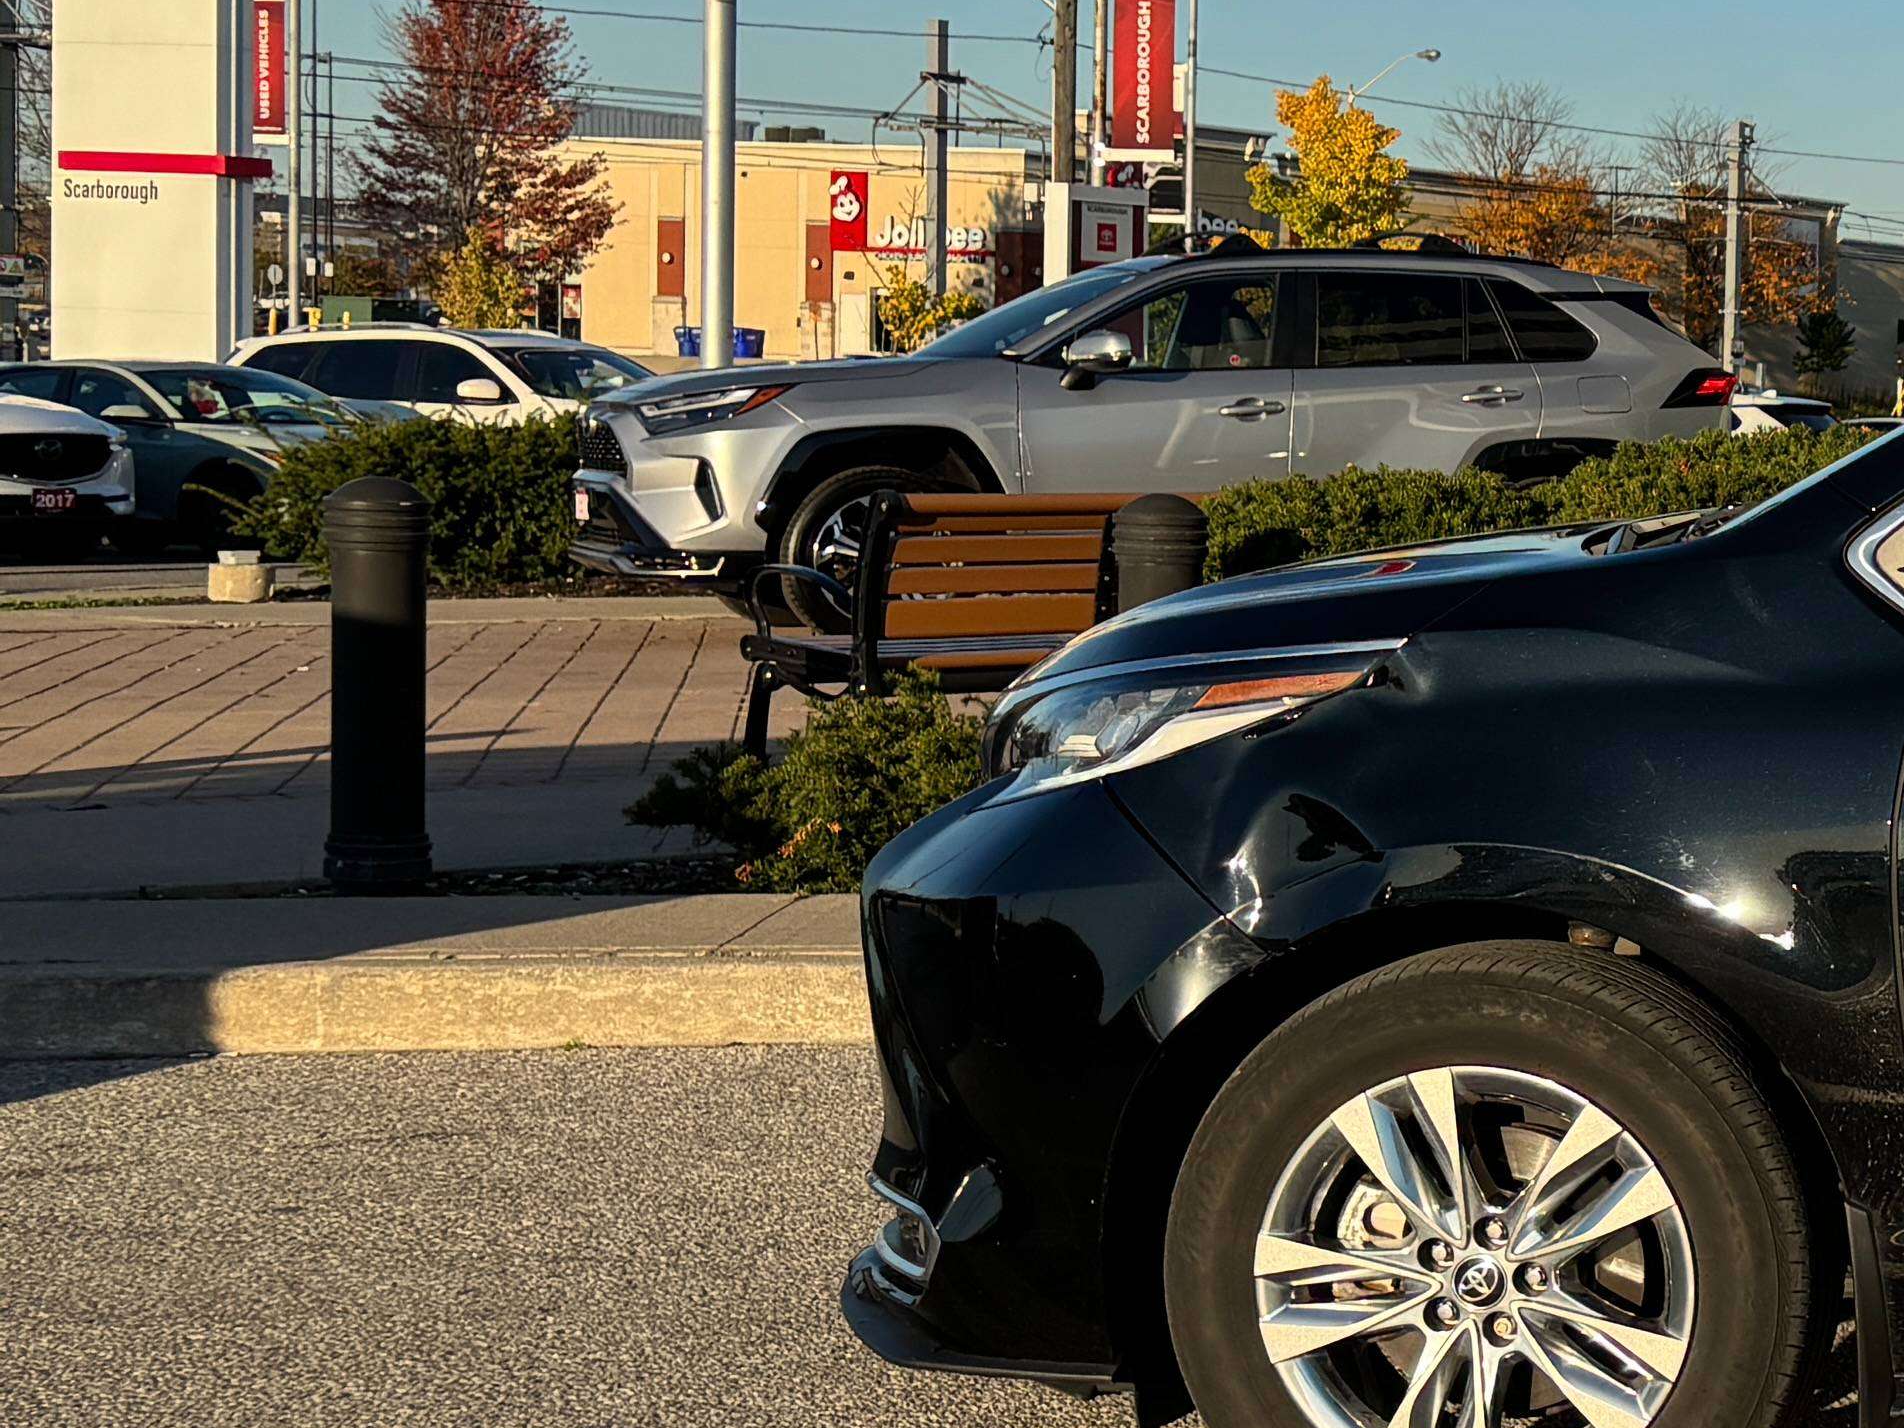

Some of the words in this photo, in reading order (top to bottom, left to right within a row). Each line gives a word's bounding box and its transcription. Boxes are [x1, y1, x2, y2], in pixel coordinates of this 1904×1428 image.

[258, 9, 270, 78] VEHICLES
[1136, 1, 1151, 144] SCARBOROUGH
[258, 80, 270, 120] USED
[64, 178, 158, 204] Scarborough
[875, 215, 987, 251] Jollee
[35, 493, 75, 508] 2017
